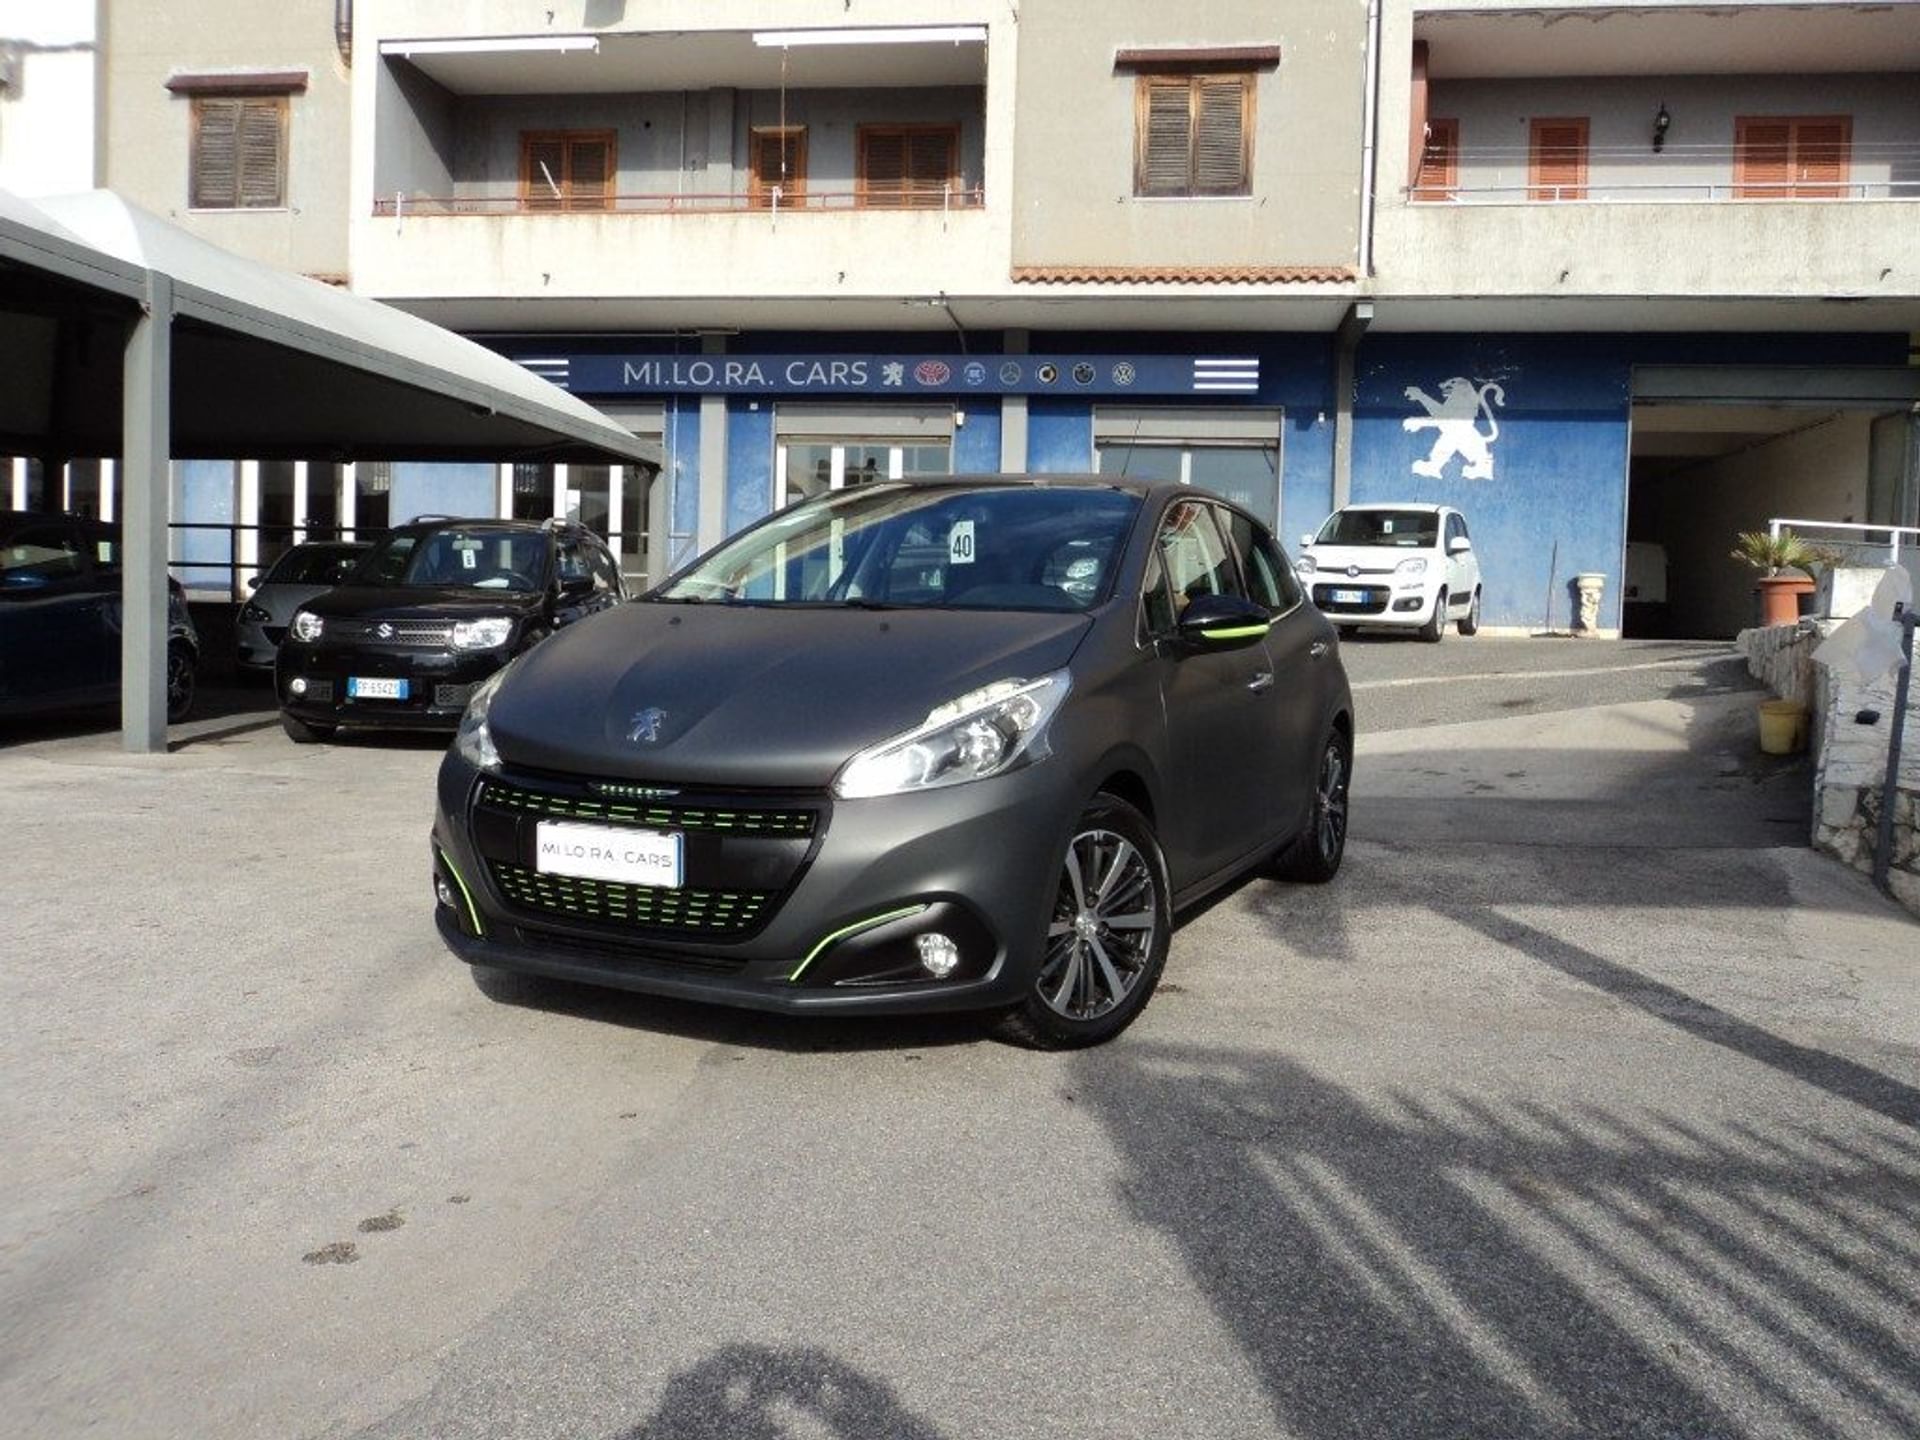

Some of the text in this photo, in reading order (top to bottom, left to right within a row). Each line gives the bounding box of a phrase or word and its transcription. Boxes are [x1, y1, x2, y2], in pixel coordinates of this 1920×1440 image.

[624, 362, 868, 386] MI.LO.RA. CARS
[952, 534, 972, 558] 40
[624, 850, 673, 868] CARS
